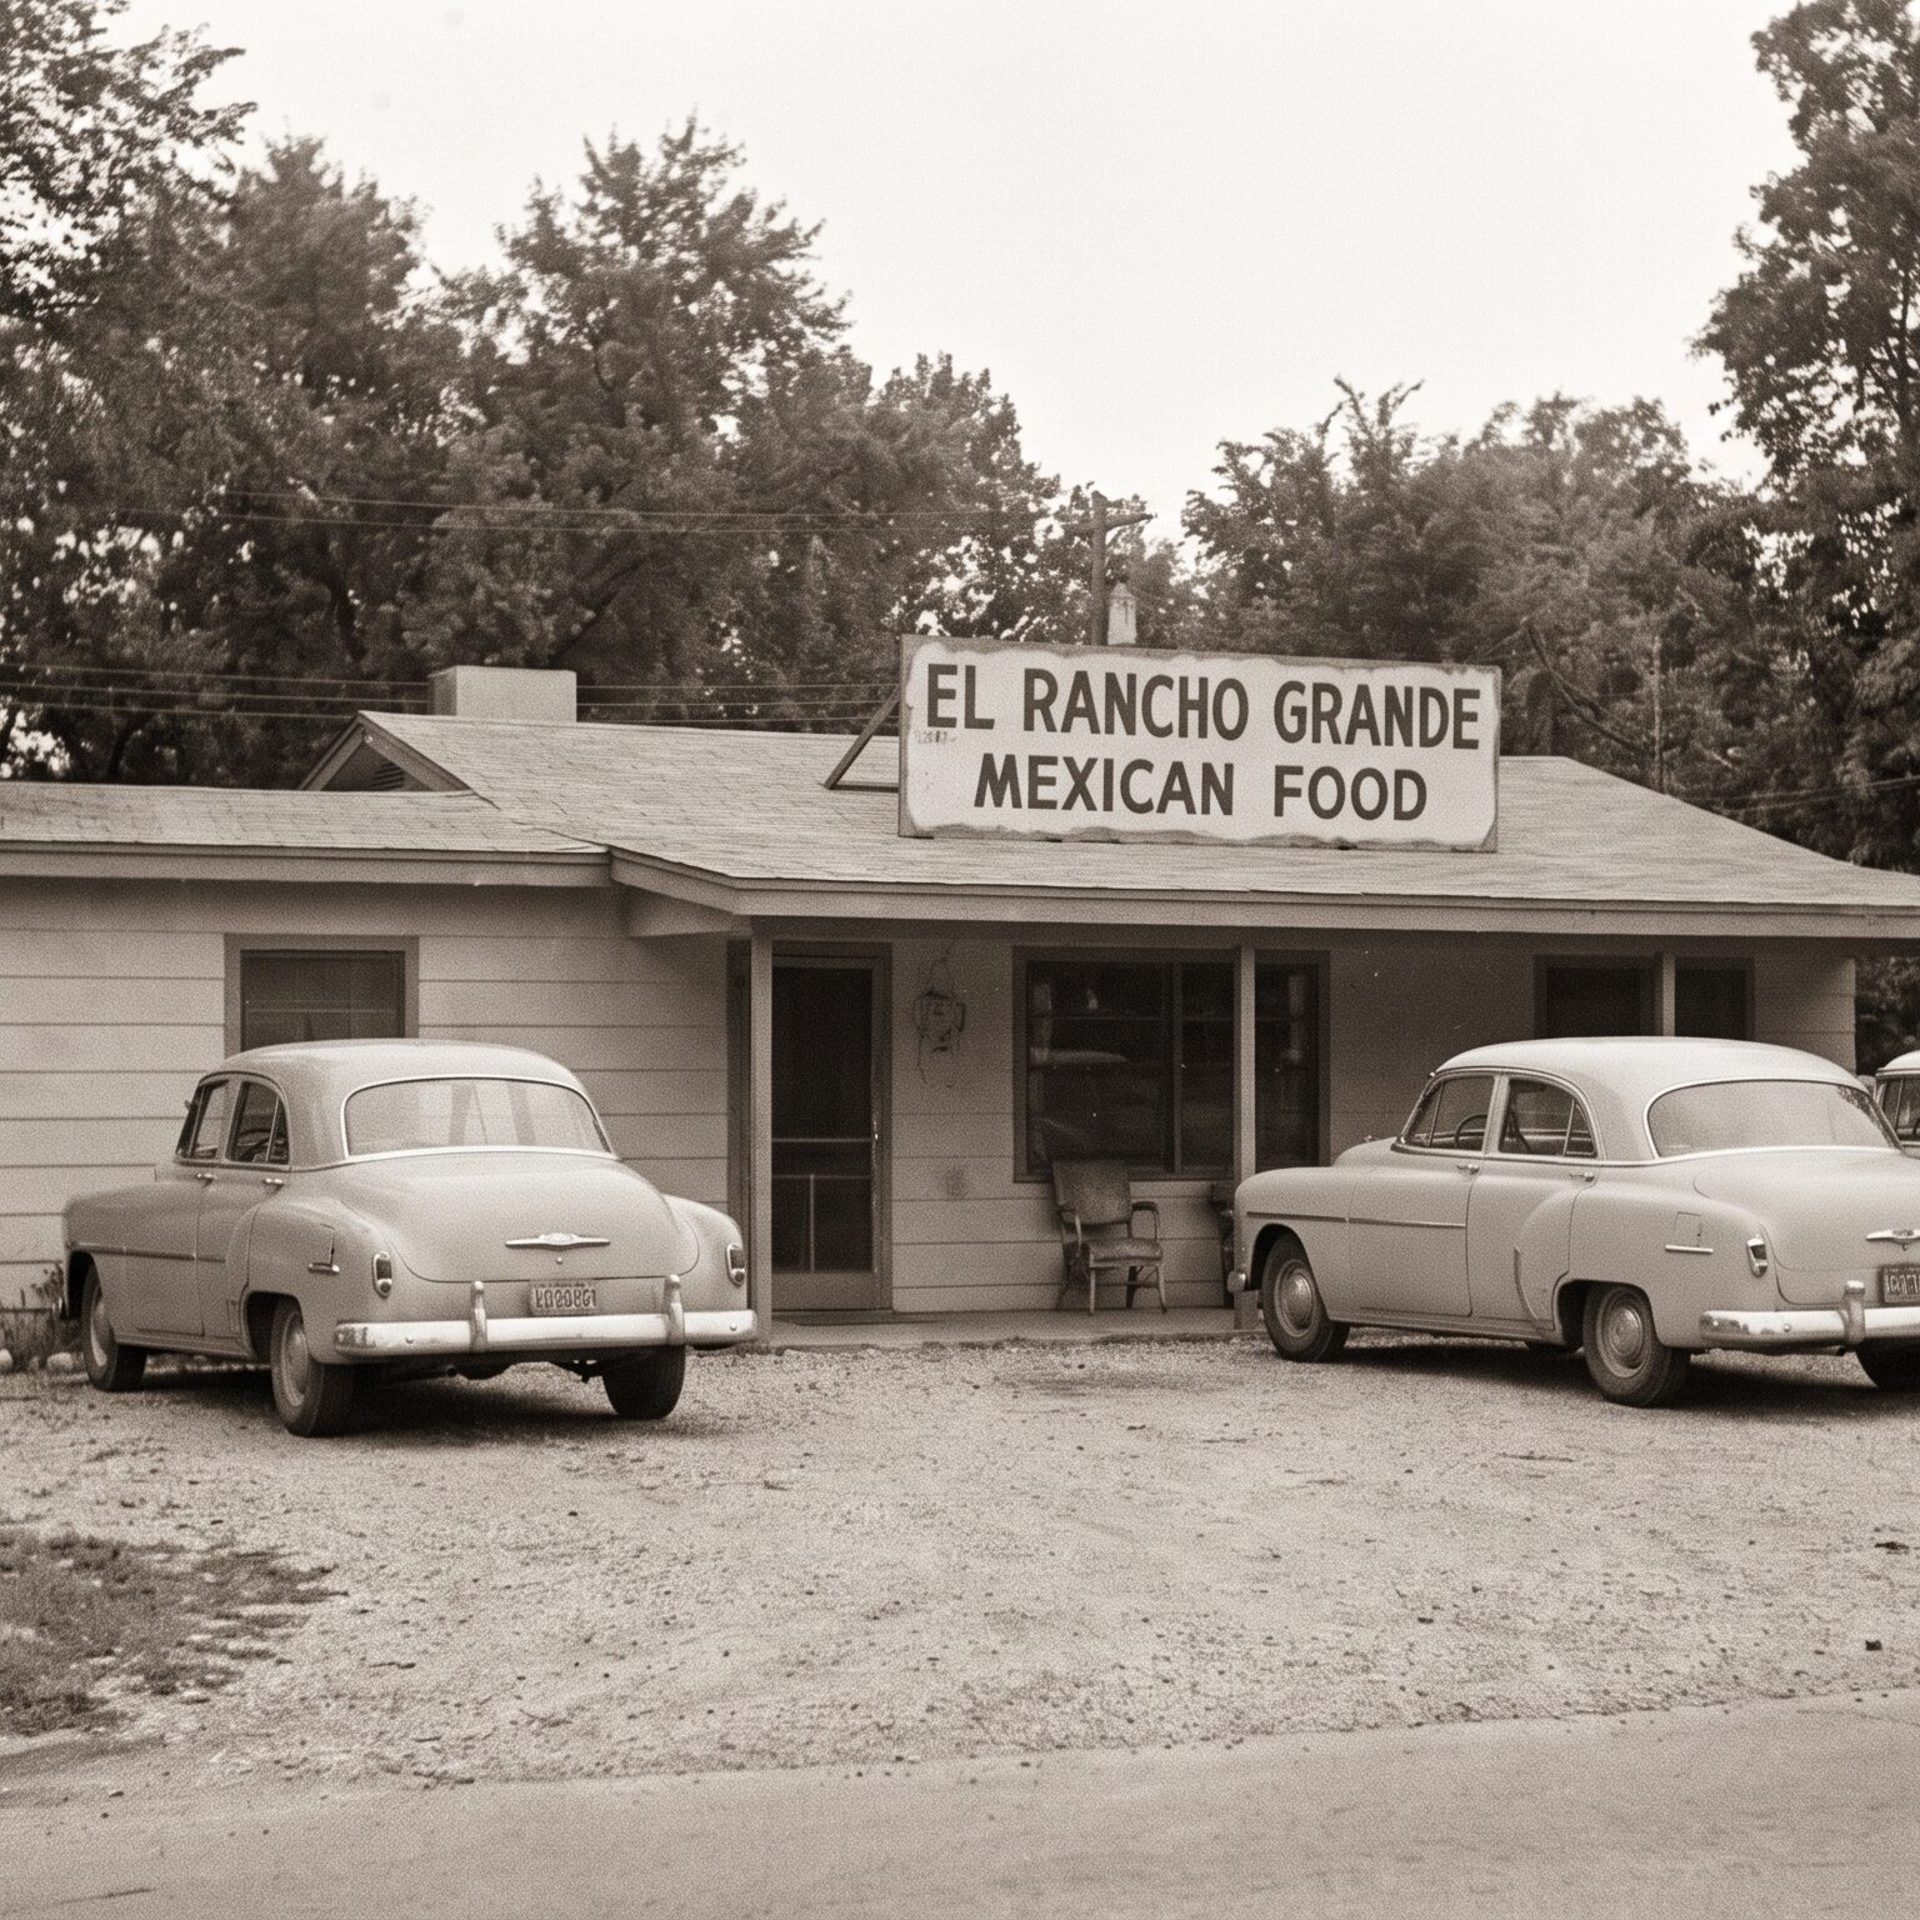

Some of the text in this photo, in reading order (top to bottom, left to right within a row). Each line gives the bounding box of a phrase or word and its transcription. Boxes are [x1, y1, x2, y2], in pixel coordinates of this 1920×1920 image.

[927, 663, 1481, 750] EL RANCHO GRANDE
[974, 753, 1427, 821] MEXICAN FOOD
